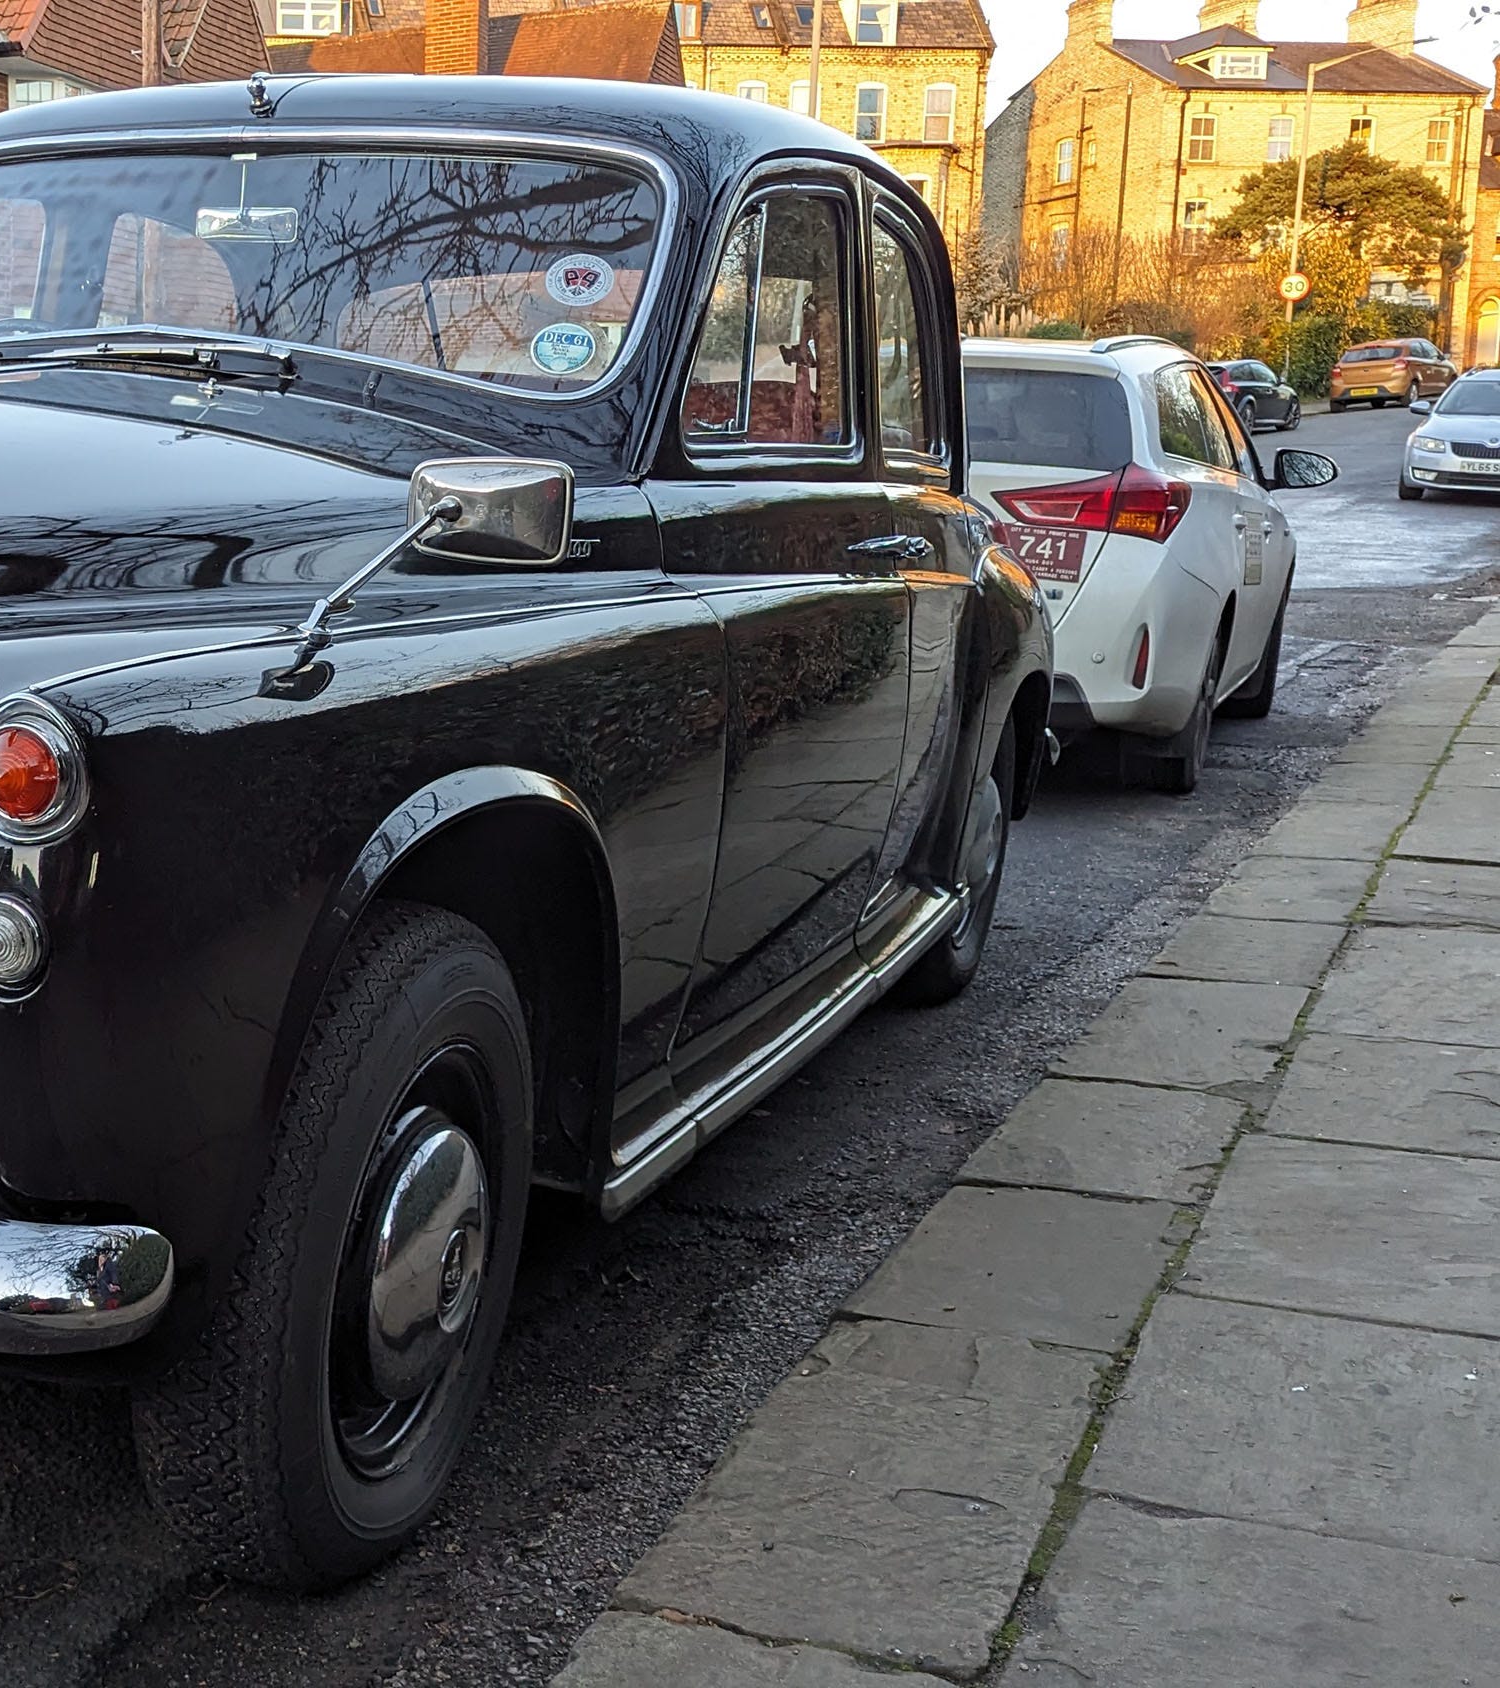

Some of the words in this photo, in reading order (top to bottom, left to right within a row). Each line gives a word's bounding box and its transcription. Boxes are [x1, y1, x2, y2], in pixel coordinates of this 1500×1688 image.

[1284, 280, 1305, 293] 30
[543, 331, 571, 344] DEC
[573, 335, 589, 347] 61
[1466, 463, 1491, 472] YL65
[1019, 535, 1067, 561] 741
